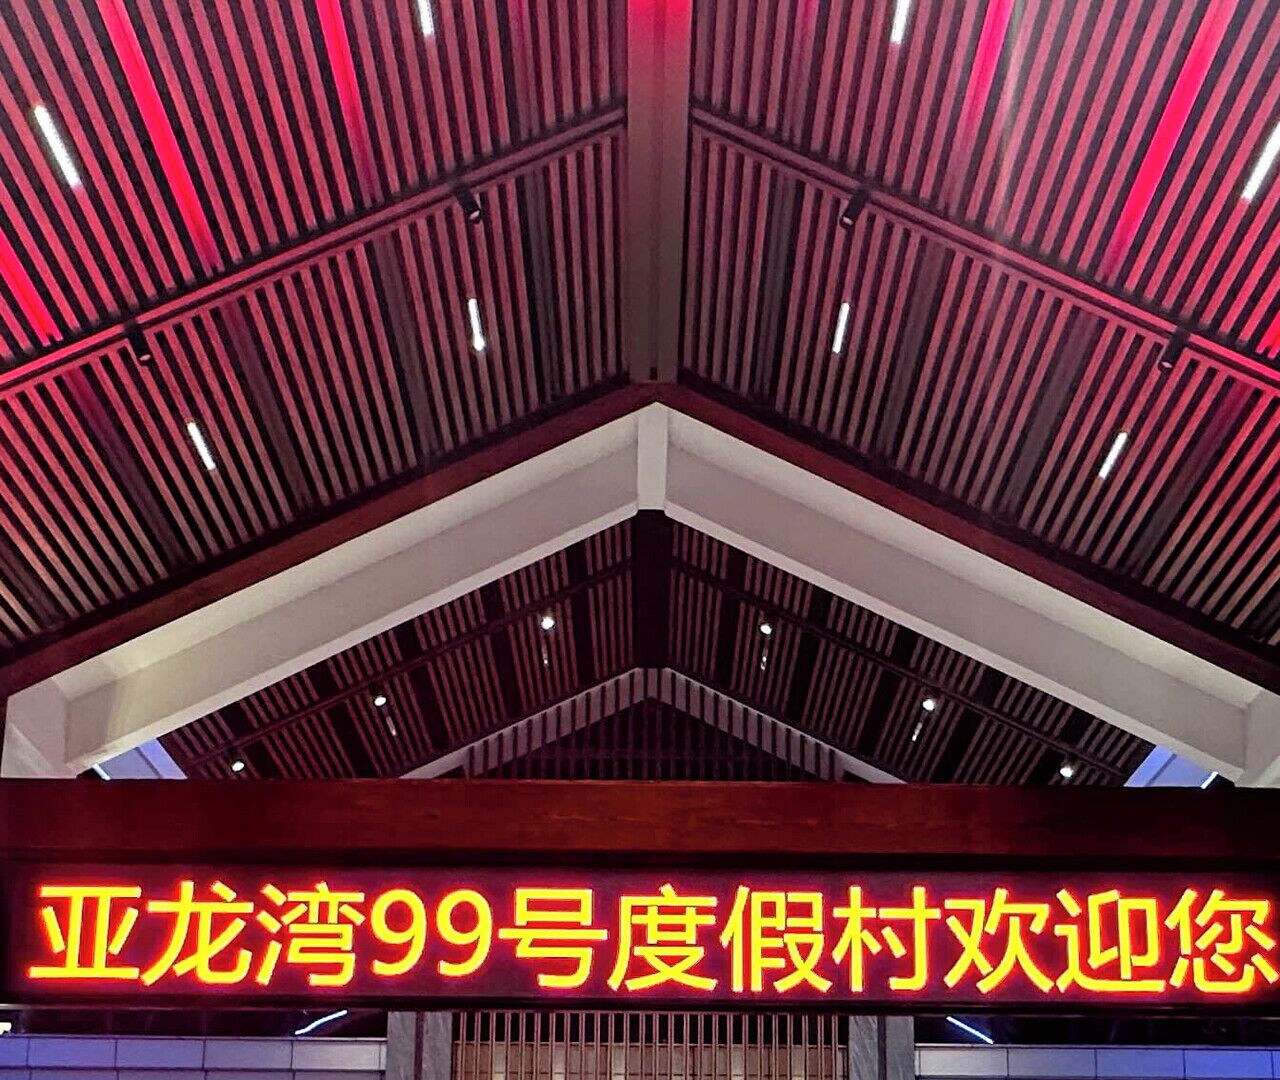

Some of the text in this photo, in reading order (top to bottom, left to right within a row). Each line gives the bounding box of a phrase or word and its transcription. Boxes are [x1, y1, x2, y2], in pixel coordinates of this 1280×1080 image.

[27, 880, 1280, 994] 亚龙湾99号度假村欢迎您
